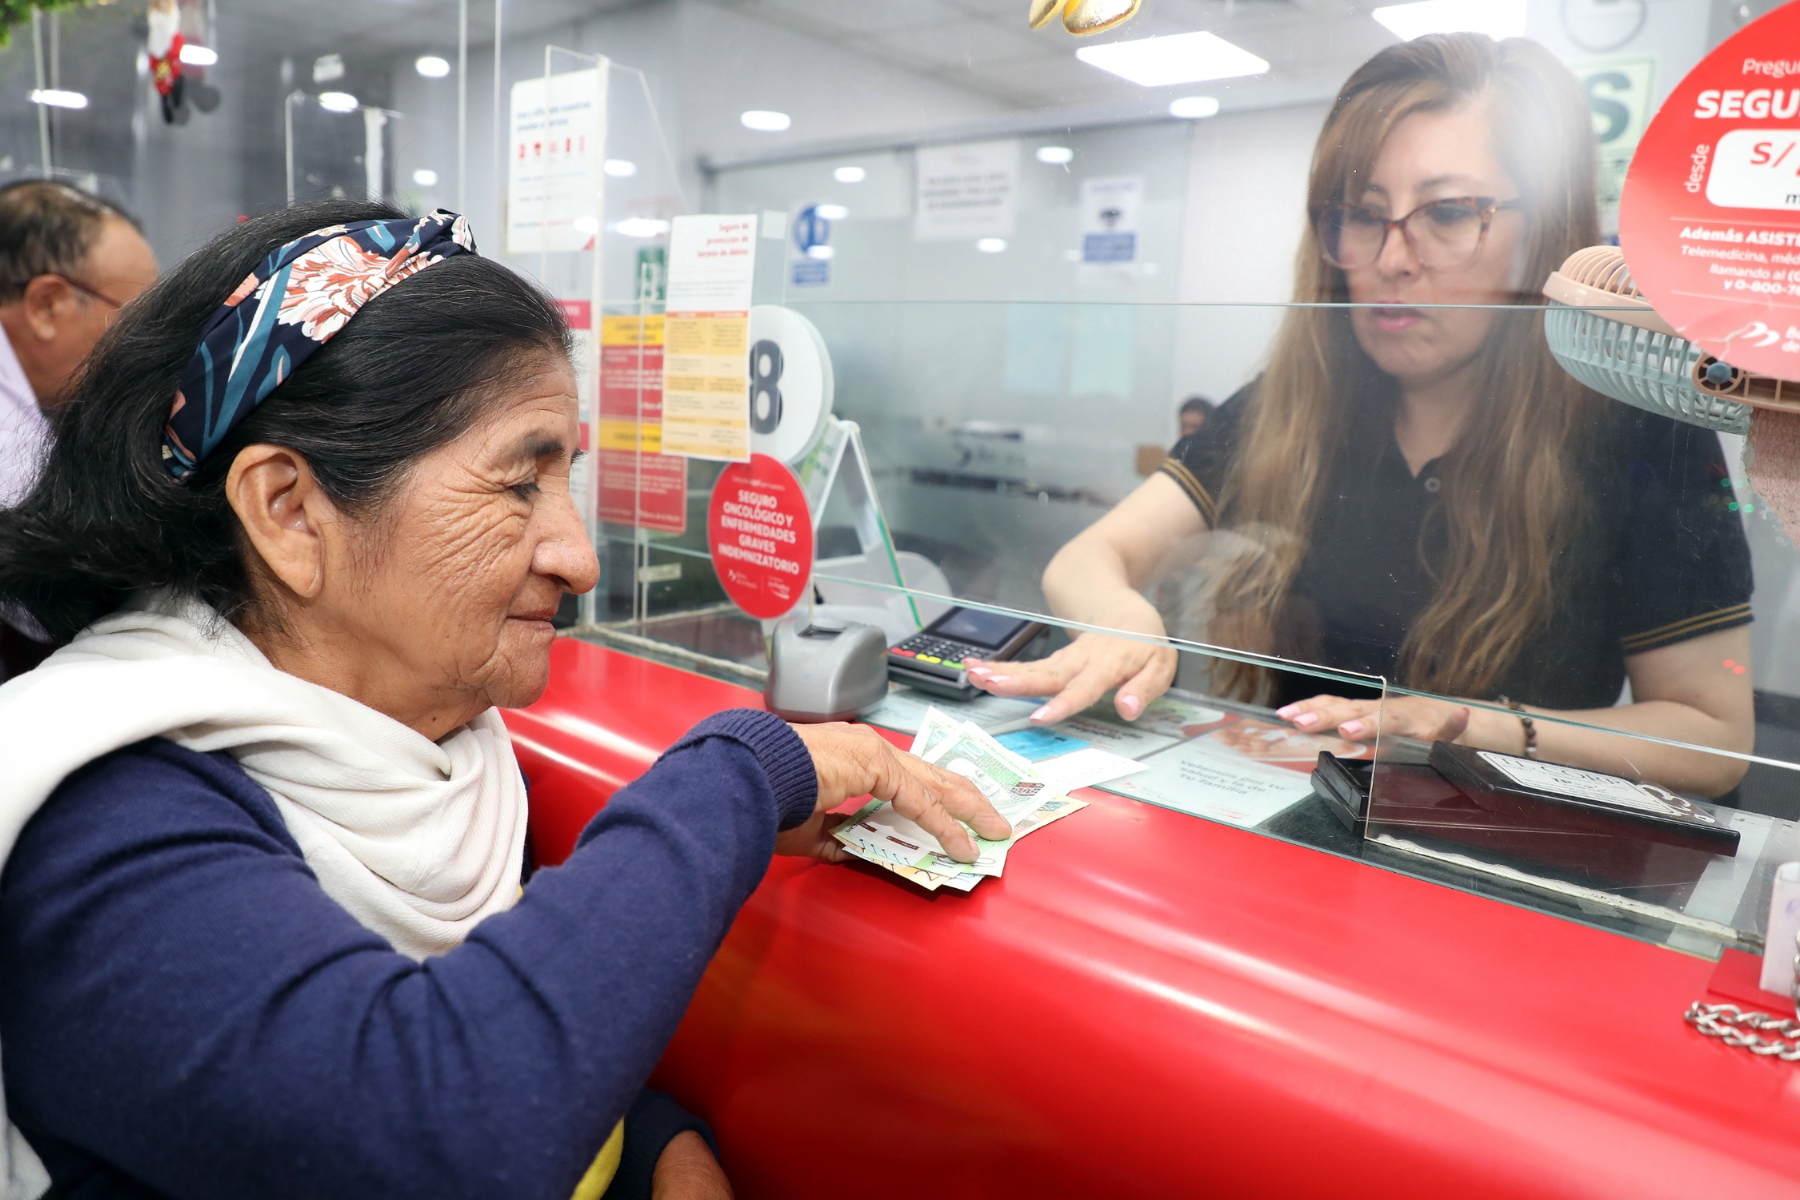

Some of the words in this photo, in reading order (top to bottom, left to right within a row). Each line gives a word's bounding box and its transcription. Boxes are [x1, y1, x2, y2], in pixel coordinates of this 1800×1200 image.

[1742, 58, 1800, 78] Pregu
[1693, 88, 1800, 119] SEGU
[1684, 143, 1710, 193] desde
[1679, 226, 1744, 243] Además
[1681, 244, 1768, 264] Telemedicina,
[1708, 263, 1771, 280] llamando
[1772, 268, 1786, 281] al
[1724, 279, 1733, 290] y
[737, 489, 778, 509] SEGURO
[723, 501, 785, 526] ONCOLÓGICO
[786, 514, 794, 528] Y
[721, 515, 796, 544] ENFERMEDADES
[738, 533, 776, 554] GRAVES
[718, 542, 800, 575] INDEMNIZATORIO
[1181, 767, 1219, 780] salud
[1181, 759, 1237, 778] Velamos
[1239, 777, 1264, 786] por
[1268, 783, 1286, 791] tu
[1181, 773, 1195, 781] tu
[1199, 779, 1247, 795] familia
